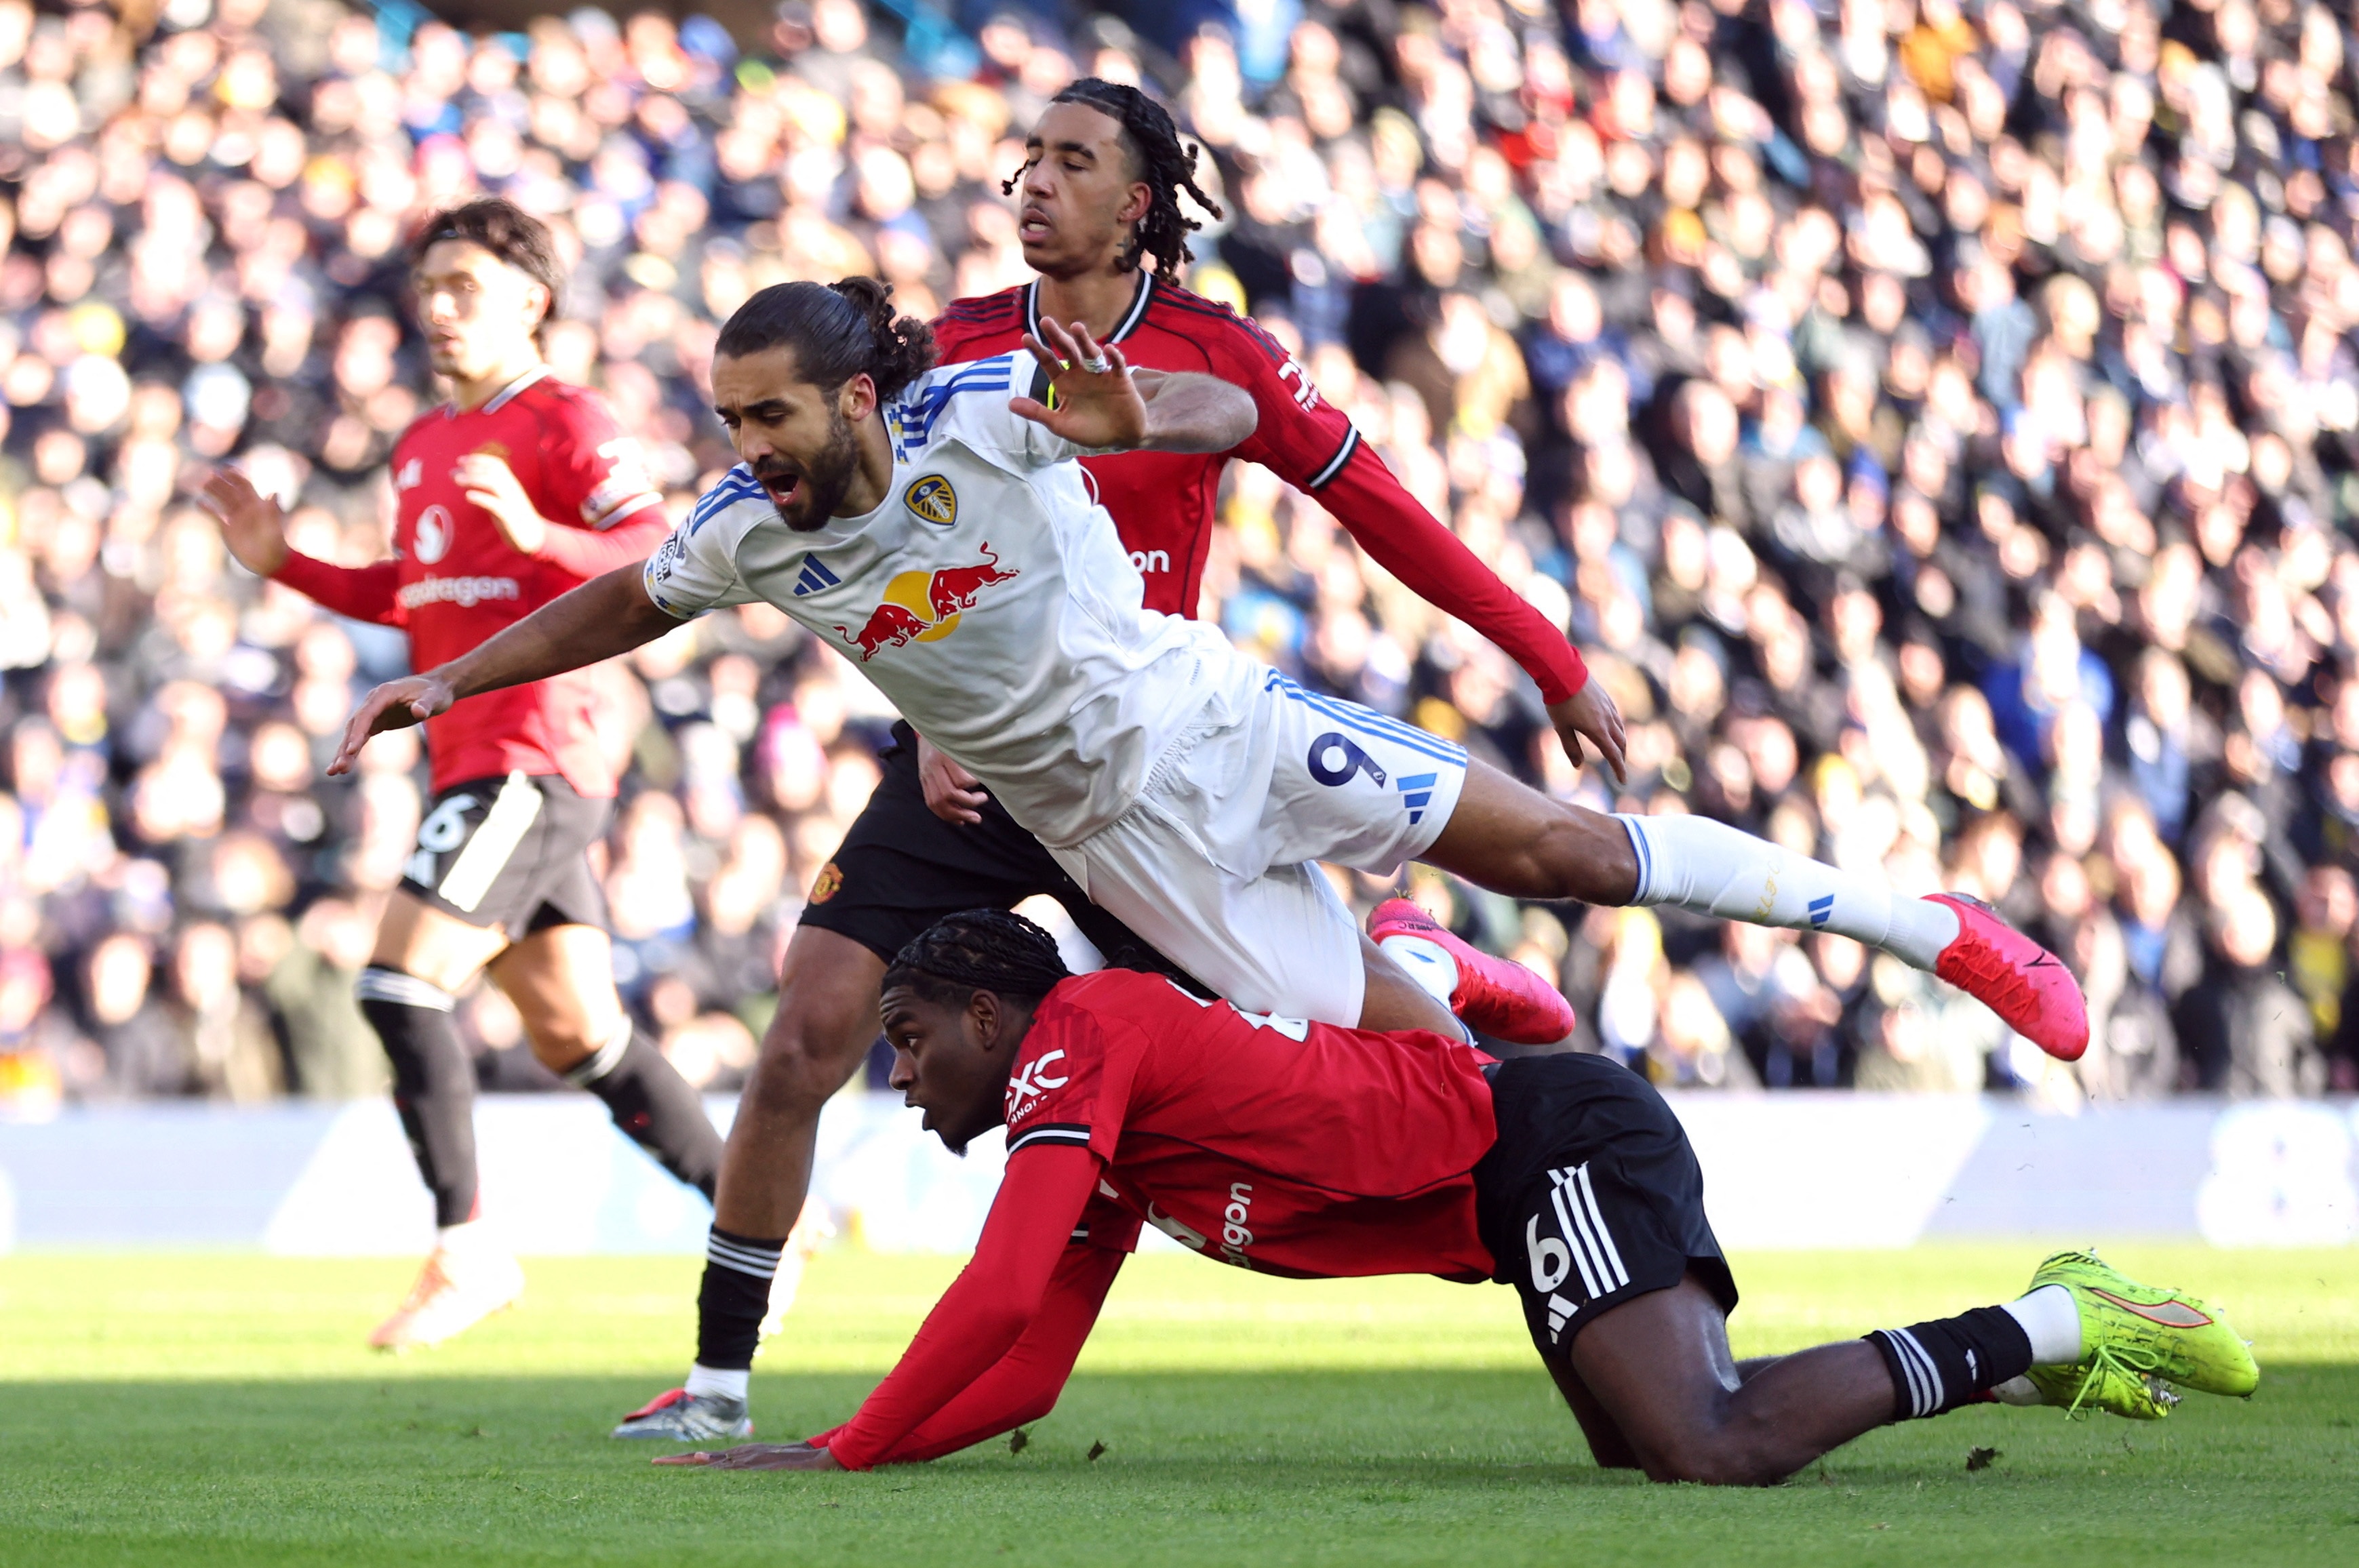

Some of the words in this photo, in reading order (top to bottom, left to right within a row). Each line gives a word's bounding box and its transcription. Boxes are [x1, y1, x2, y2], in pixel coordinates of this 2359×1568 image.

[1307, 732, 1387, 790] 9
[418, 793, 478, 852] 6
[1526, 1213, 1570, 1293] 6
